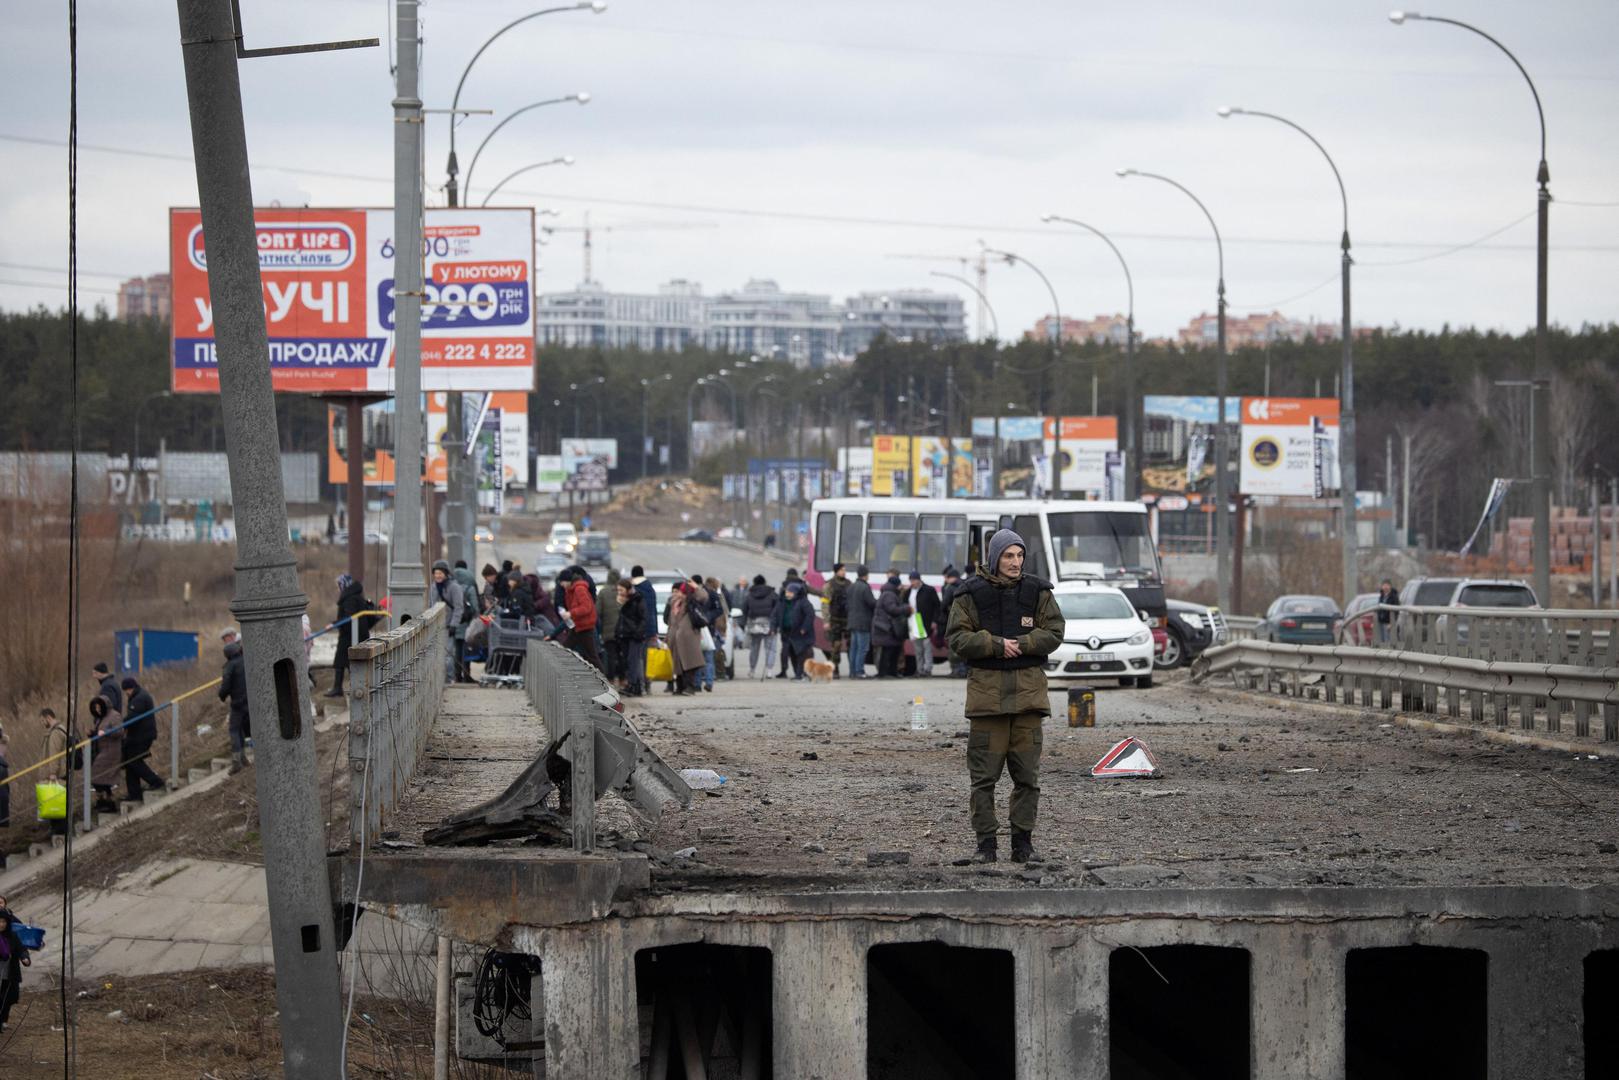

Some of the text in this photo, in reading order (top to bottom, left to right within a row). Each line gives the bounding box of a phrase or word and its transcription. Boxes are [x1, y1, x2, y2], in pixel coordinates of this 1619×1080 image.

[301, 232, 341, 248] LIFE
[301, 254, 332, 264] КЛУБ
[440, 265, 522, 282] у лютому
[262, 281, 349, 323] УЧІ
[500, 289, 523, 301] грн
[500, 301, 523, 317] рік
[444, 344, 475, 360] 222
[479, 344, 490, 360] 4
[494, 343, 525, 360] 222
